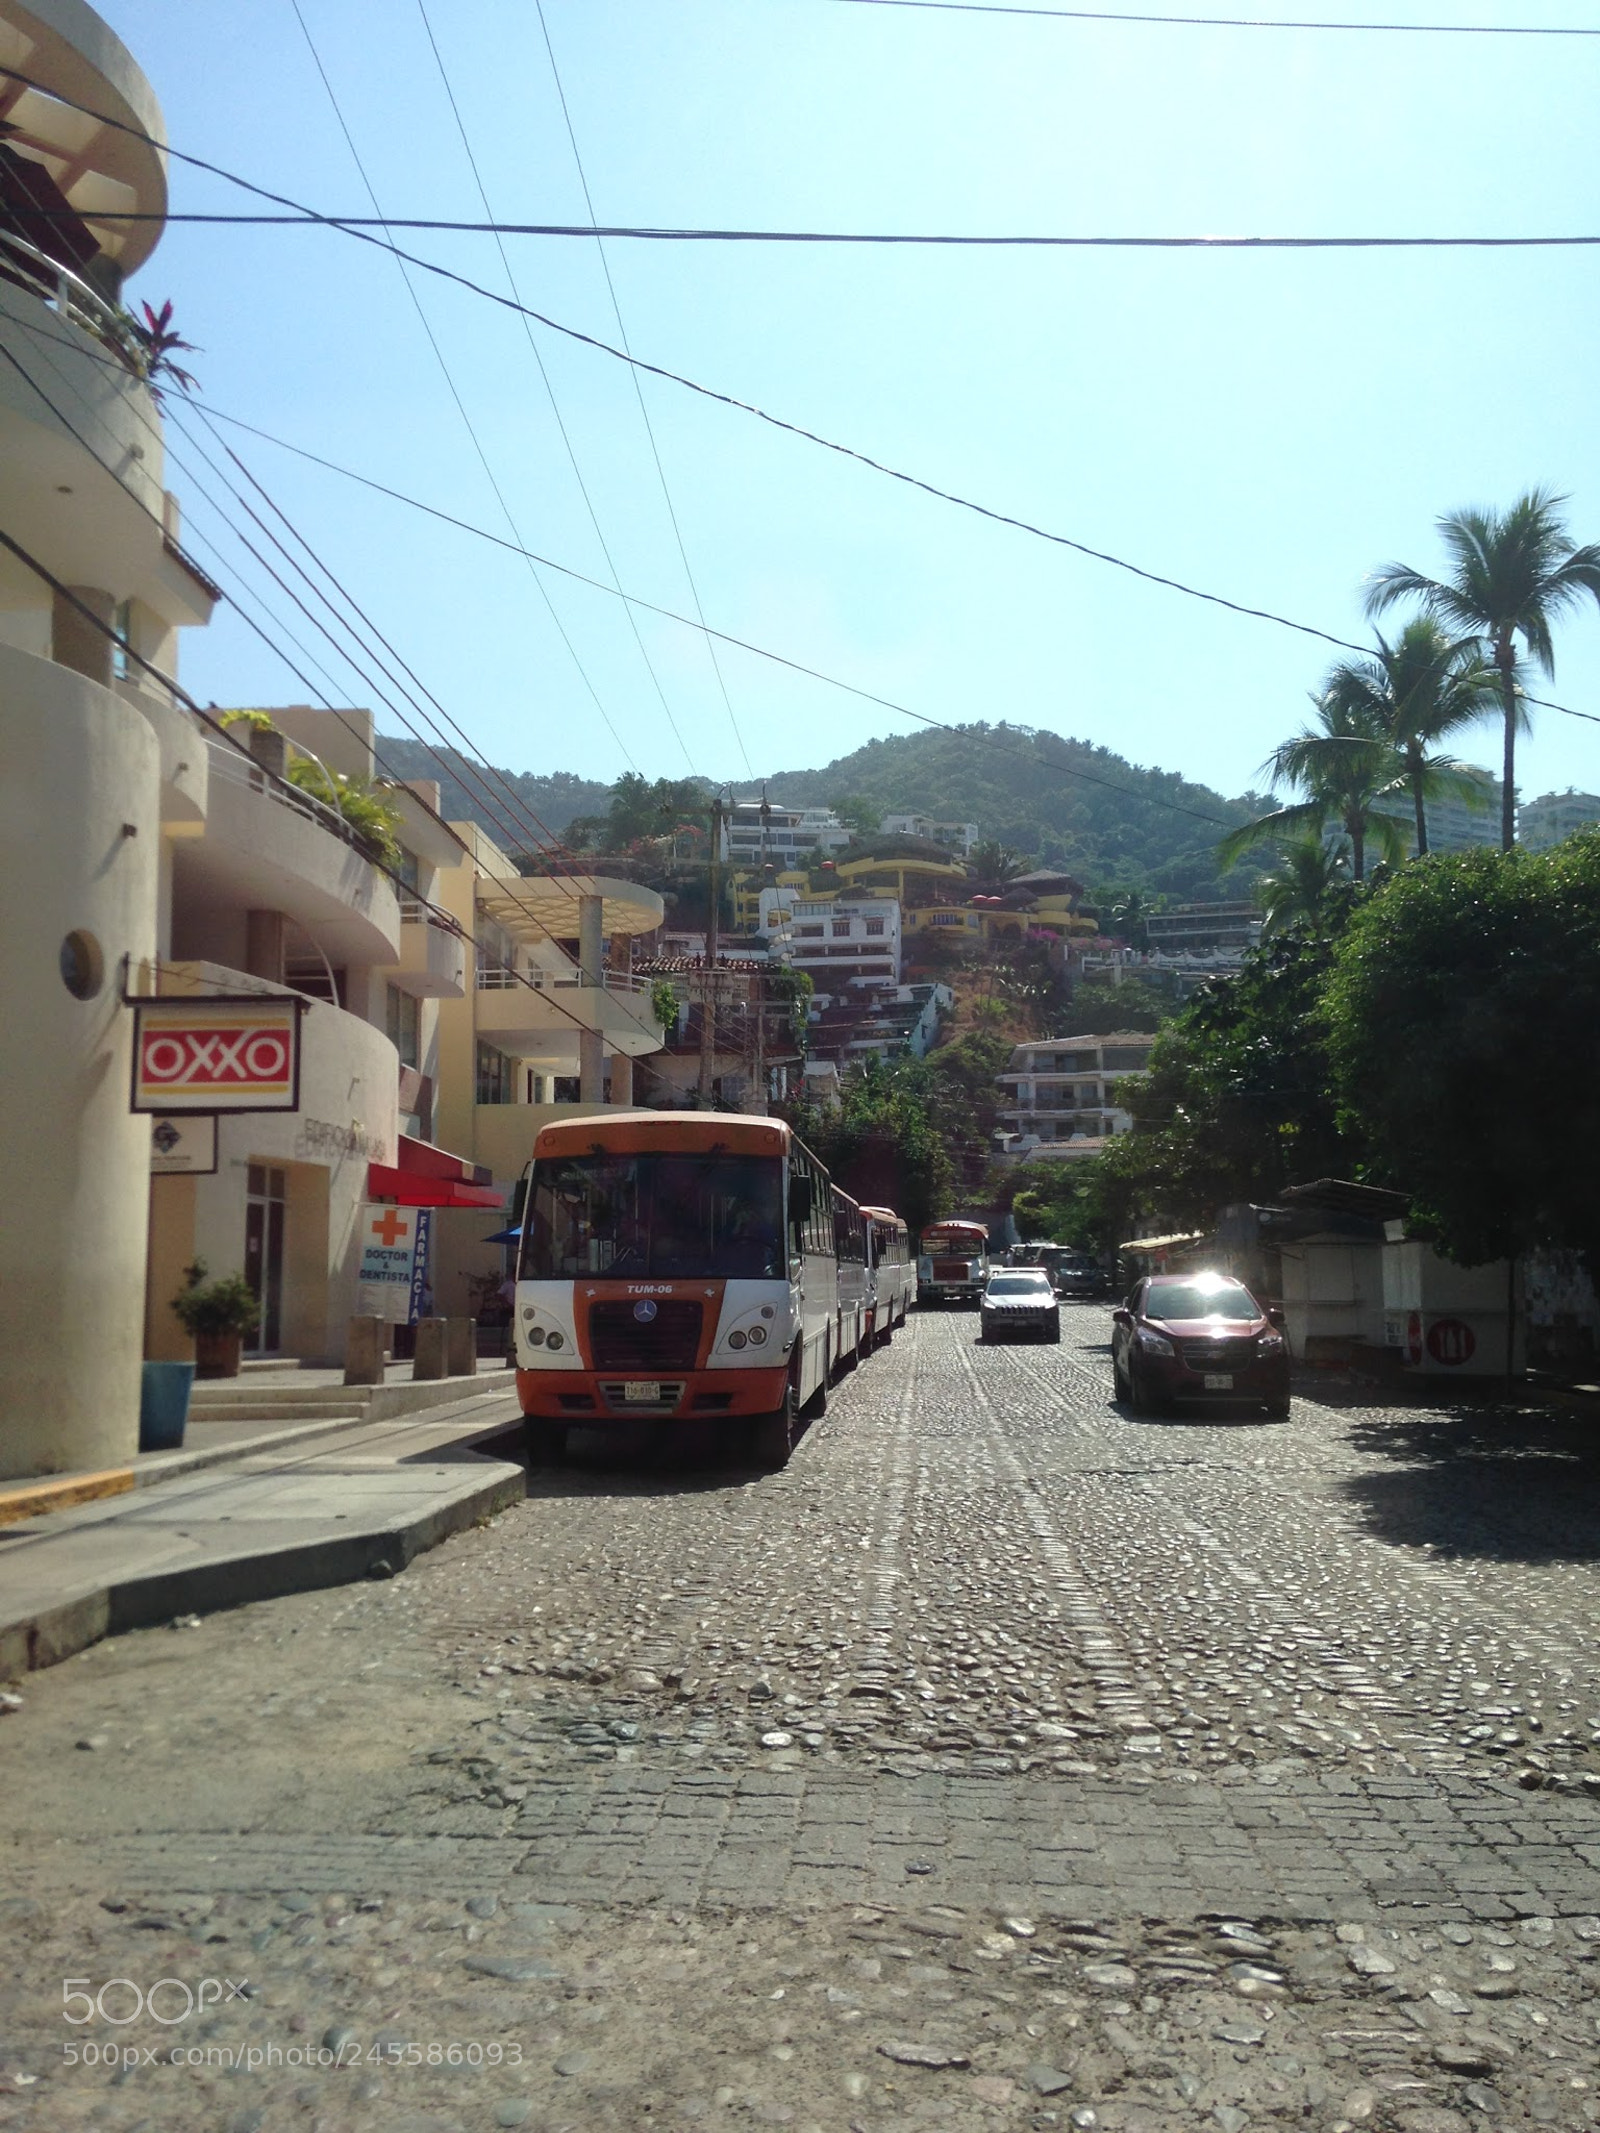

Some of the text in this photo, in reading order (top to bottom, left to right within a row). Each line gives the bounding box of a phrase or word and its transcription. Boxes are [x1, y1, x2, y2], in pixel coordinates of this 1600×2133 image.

[145, 1028, 285, 1083] OXXO
[365, 1249, 409, 1262] DOCTOR
[411, 1216, 427, 1319] FARMACIA
[359, 1269, 411, 1283] DENTISTA
[627, 1284, 673, 1294] TUM-06
